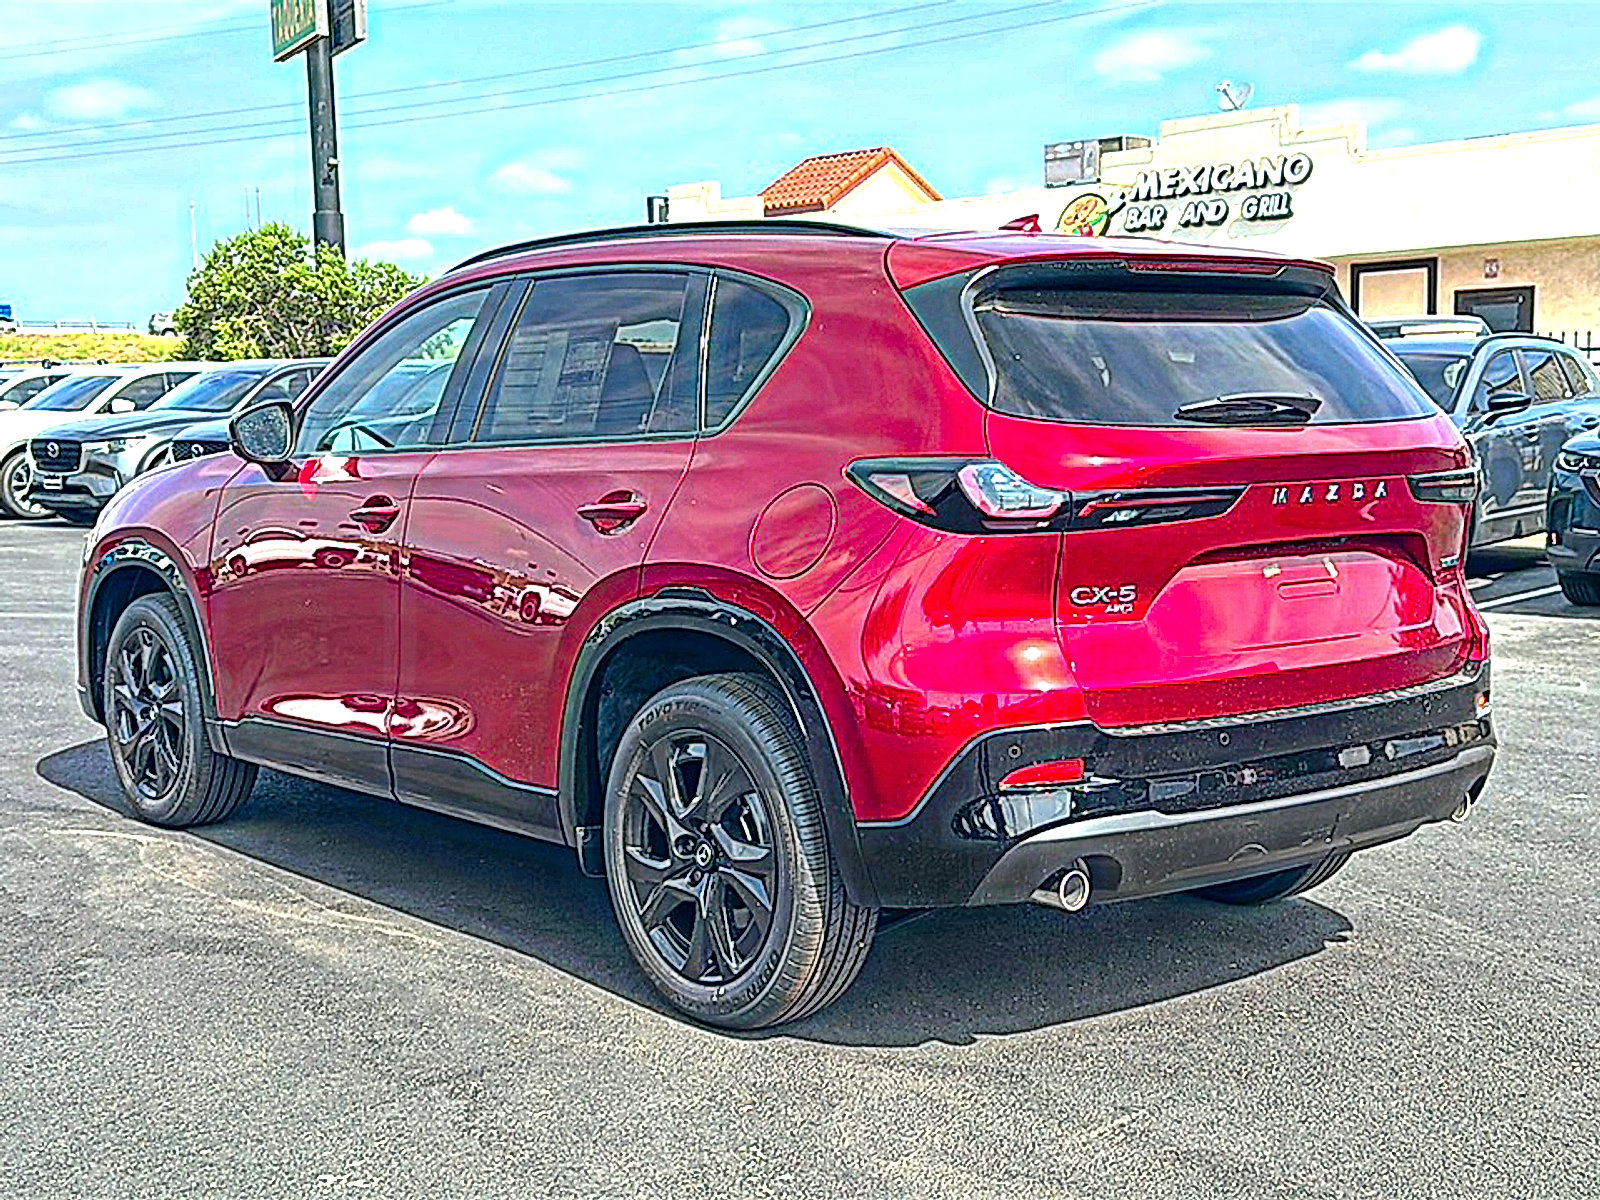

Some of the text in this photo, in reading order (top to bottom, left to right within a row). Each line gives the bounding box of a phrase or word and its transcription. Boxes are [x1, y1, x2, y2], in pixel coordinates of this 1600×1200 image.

[1129, 152, 1313, 202] MEXICANO
[1124, 192, 1294, 232] BAR AND GRILL
[1271, 481, 1387, 504] MAZDA
[1070, 584, 1137, 605] CX-5
